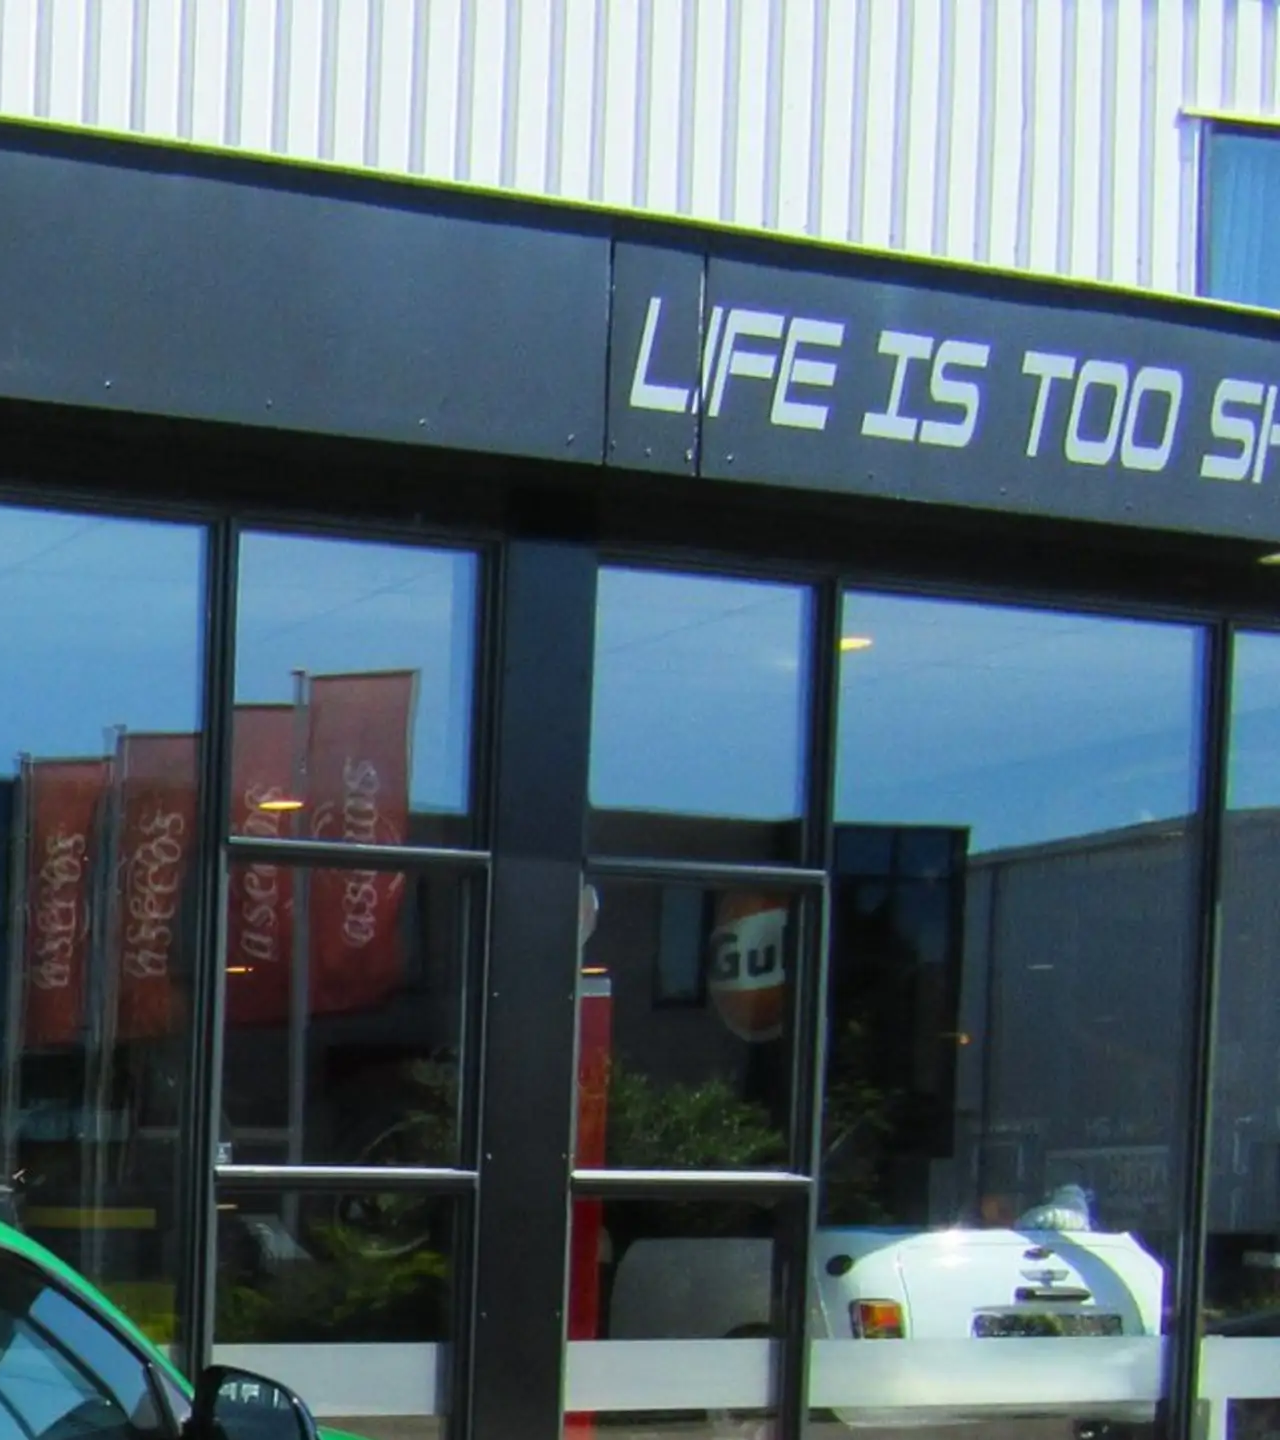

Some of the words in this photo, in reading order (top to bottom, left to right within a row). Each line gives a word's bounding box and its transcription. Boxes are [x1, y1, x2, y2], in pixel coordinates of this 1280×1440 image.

[629, 296, 845, 431] LIFE
[860, 330, 991, 449] IS
[1021, 349, 1183, 472] TOO
